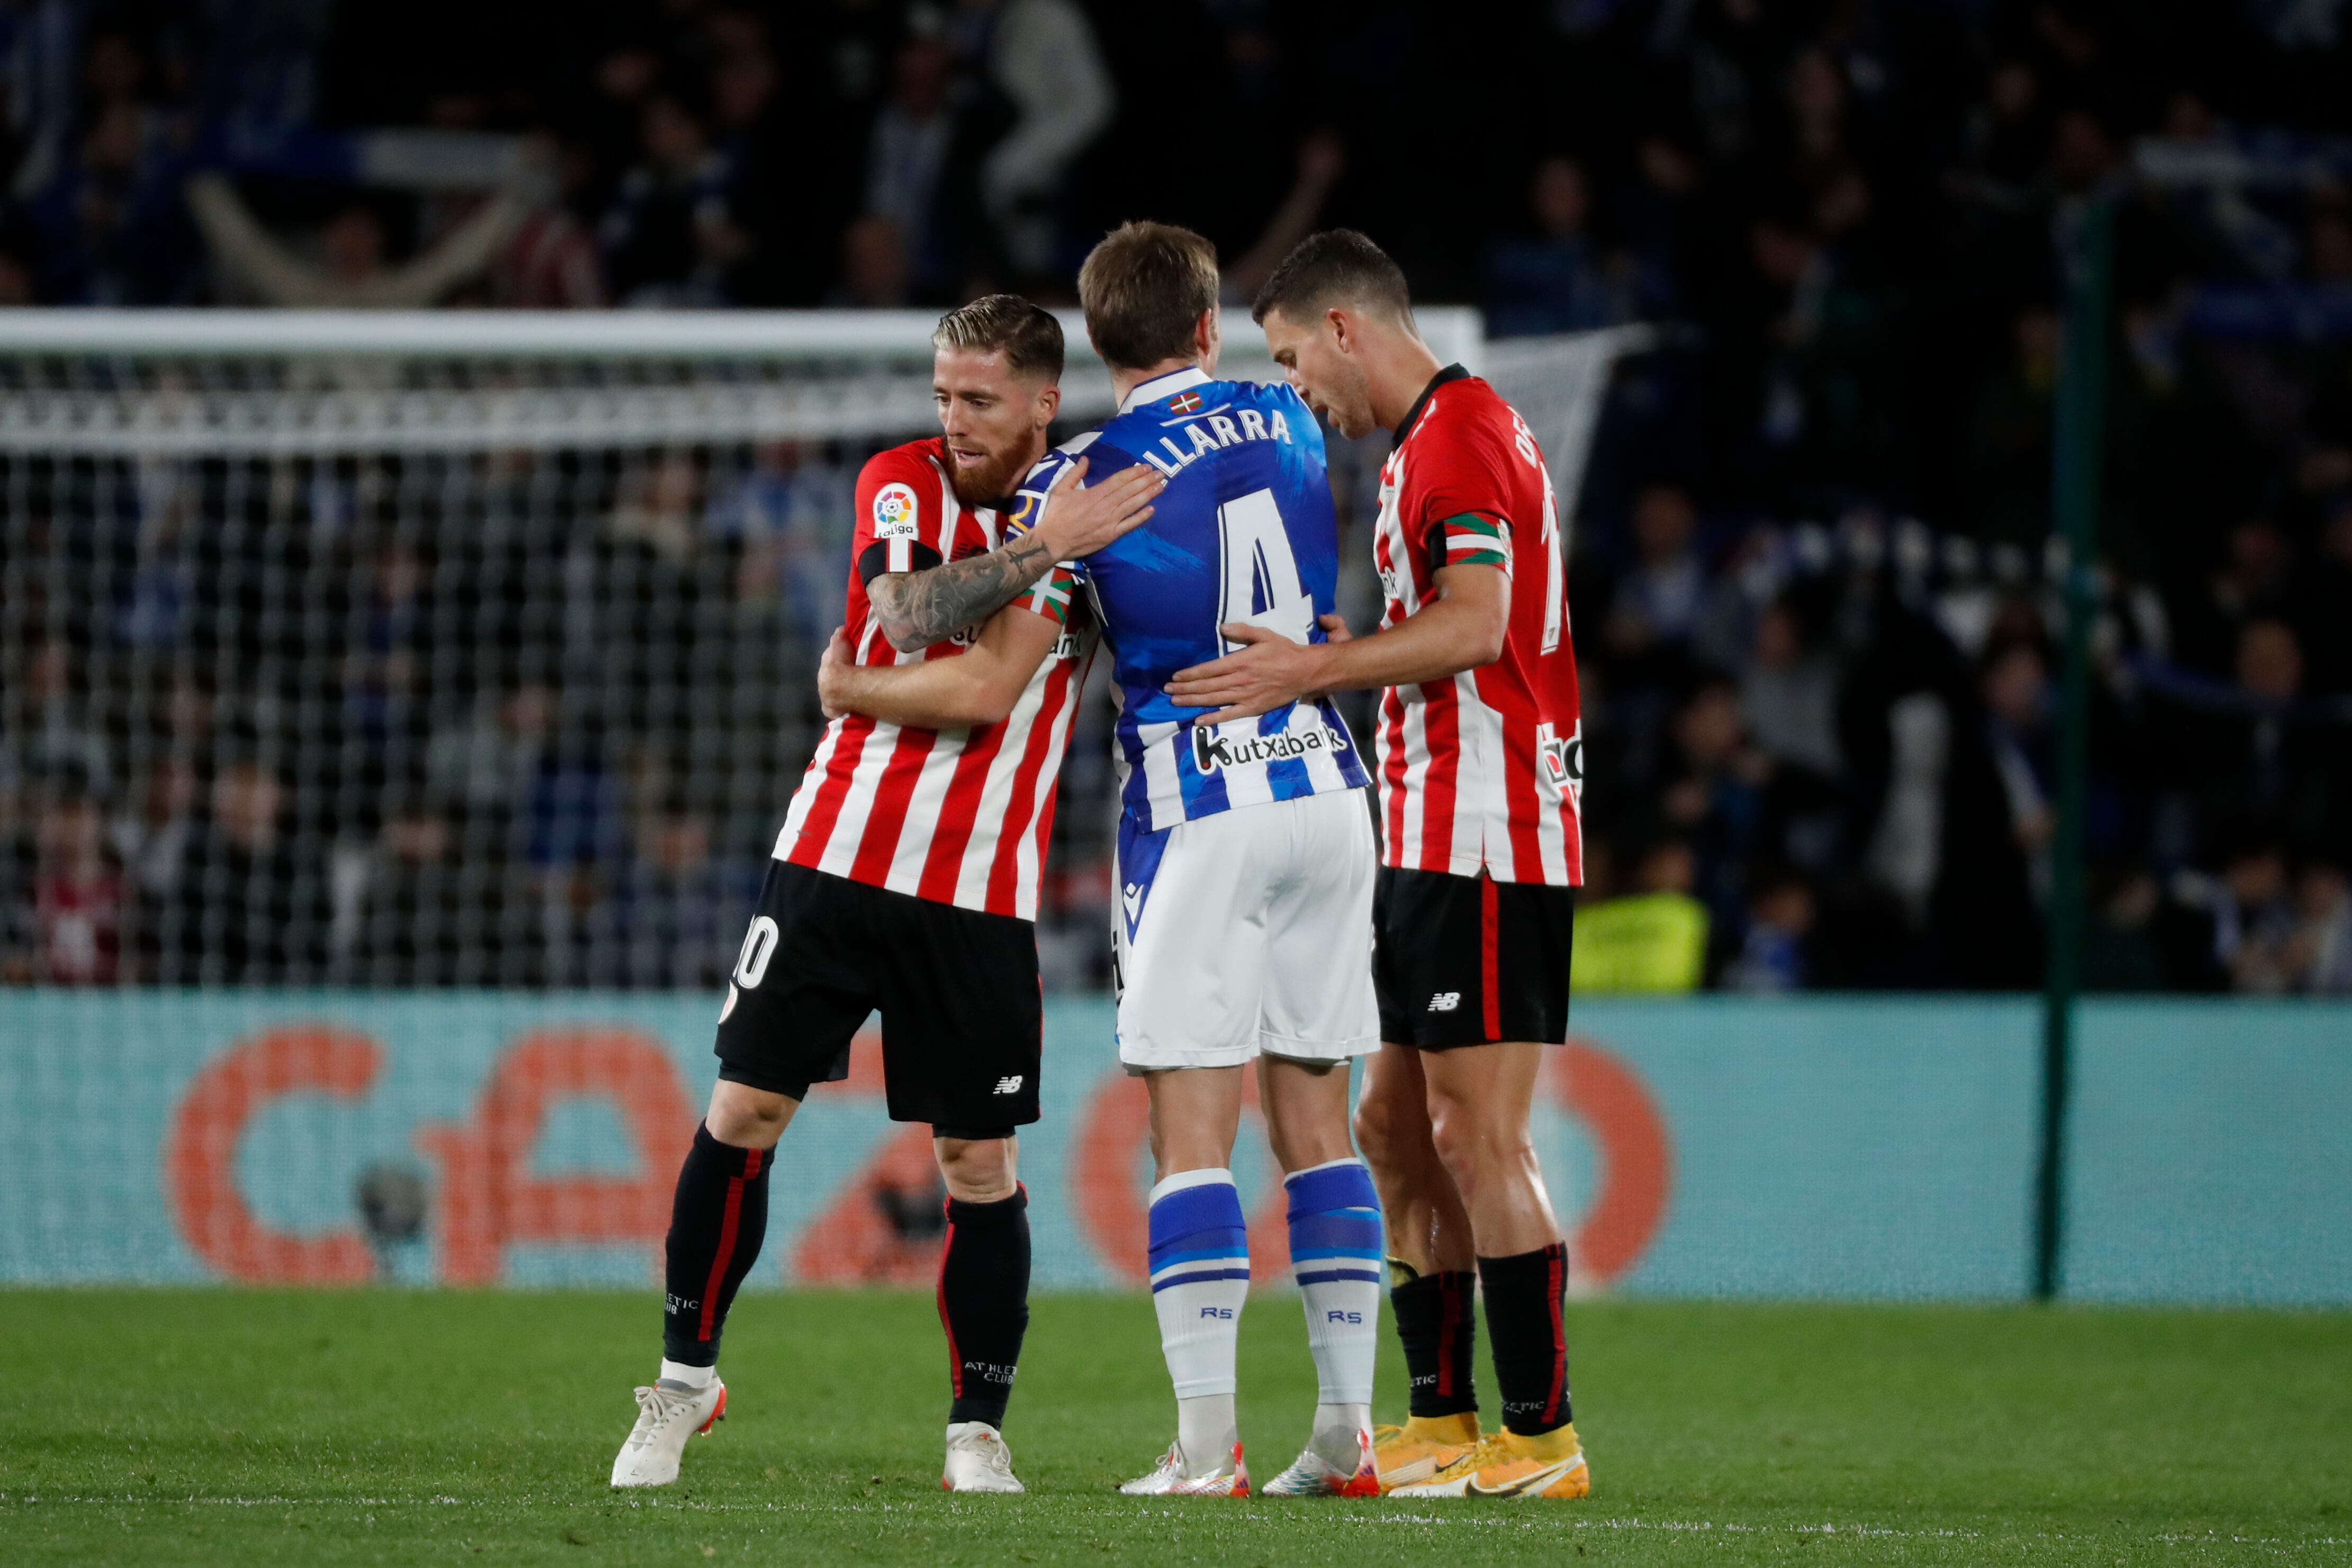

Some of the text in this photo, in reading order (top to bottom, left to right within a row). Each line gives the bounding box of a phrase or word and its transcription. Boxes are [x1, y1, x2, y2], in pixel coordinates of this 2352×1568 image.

[1134, 410, 1291, 487] LLARRA
[879, 524, 913, 538] LaLiga
[1217, 487, 1313, 660] 4
[732, 913, 779, 989] 0
[1201, 1307, 1233, 1319] RS
[1327, 1311, 1362, 1324] RS
[984, 1372, 1013, 1384] CLUB
